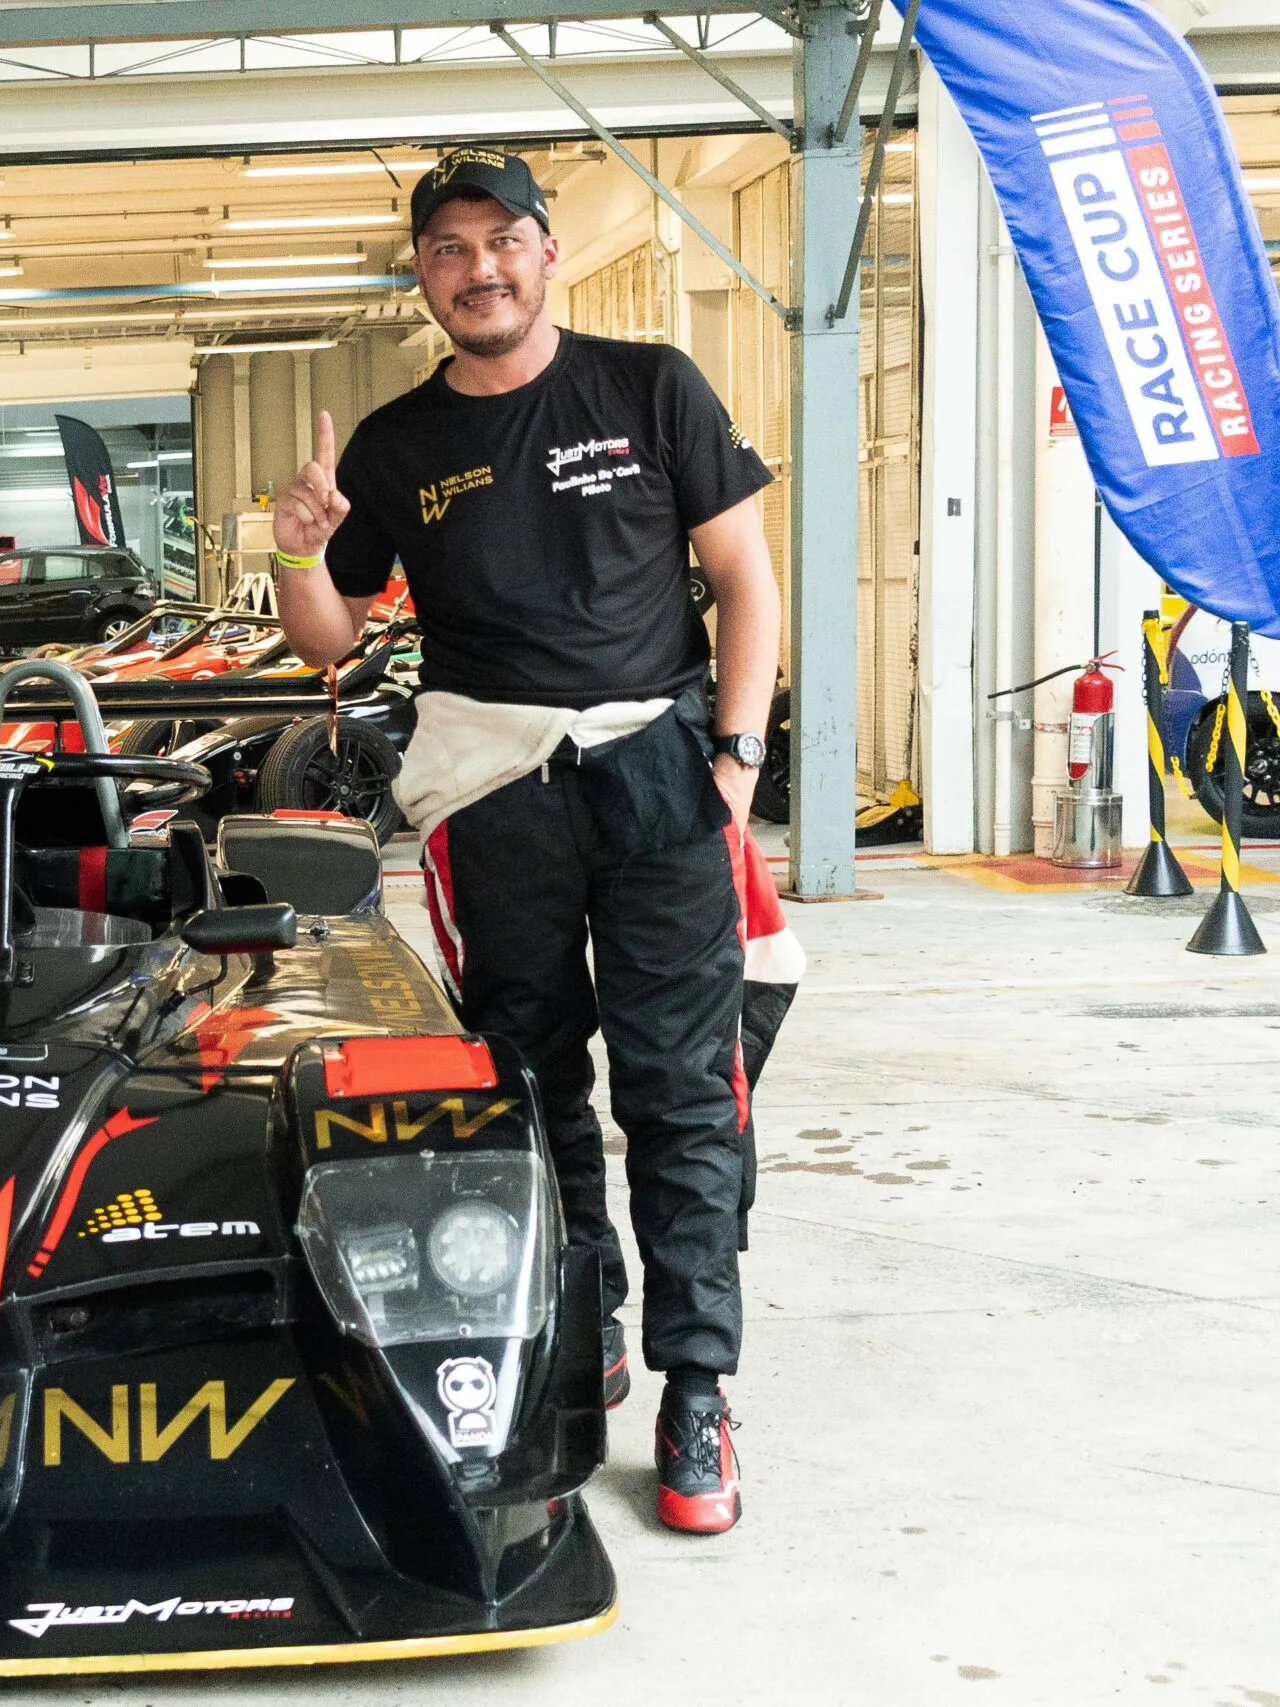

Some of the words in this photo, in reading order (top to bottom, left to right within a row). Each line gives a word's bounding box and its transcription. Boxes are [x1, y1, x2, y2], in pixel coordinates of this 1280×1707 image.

[1073, 173, 1140, 282] CUP
[1139, 166, 1201, 294] SERIES
[1114, 298, 1196, 445] RACE
[1184, 307, 1250, 437] RACING
[440, 465, 492, 489] NELSON
[442, 475, 494, 498] WILIANS
[581, 482, 612, 497] Piloto
[102, 1221, 261, 1243] atem
[44, 1377, 296, 1466] NW
